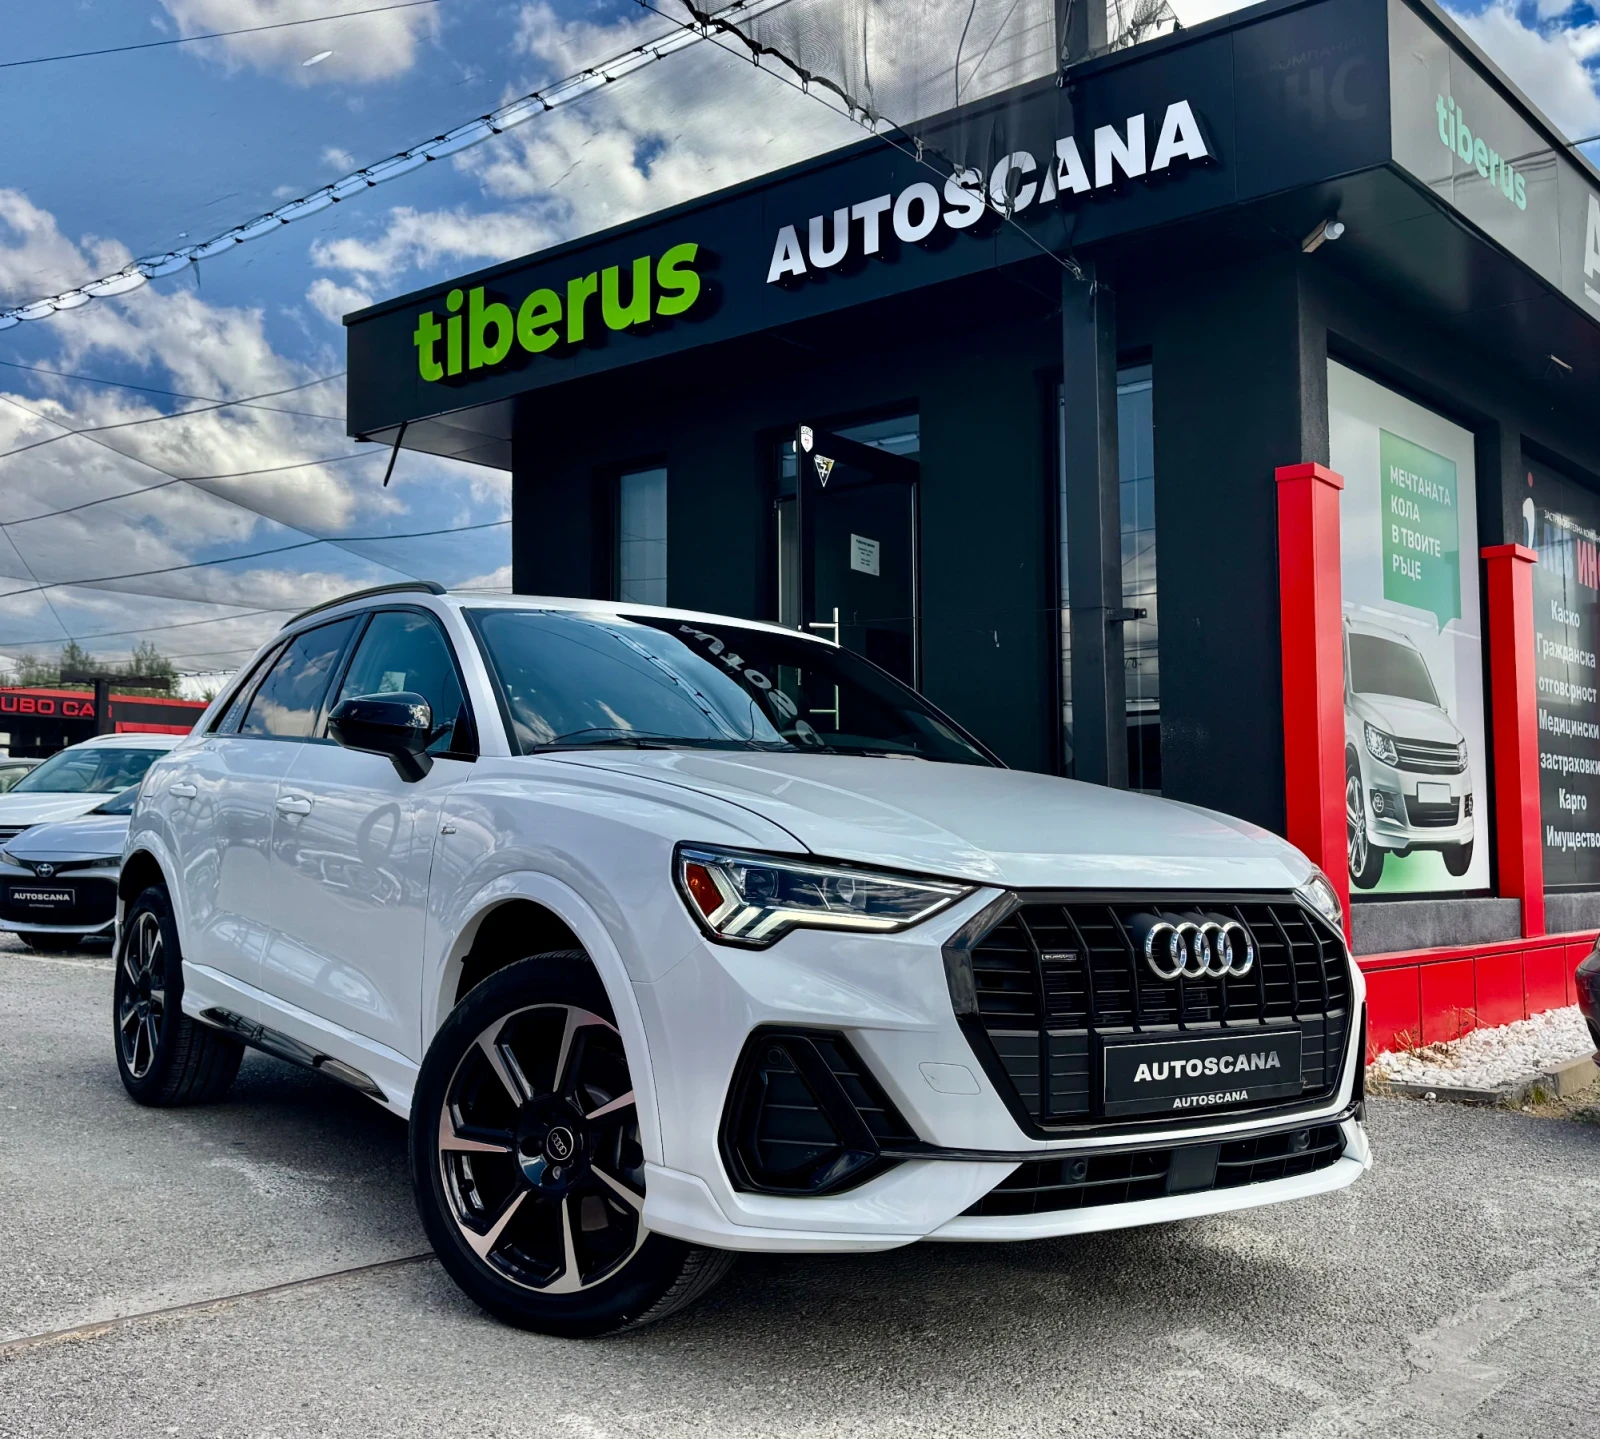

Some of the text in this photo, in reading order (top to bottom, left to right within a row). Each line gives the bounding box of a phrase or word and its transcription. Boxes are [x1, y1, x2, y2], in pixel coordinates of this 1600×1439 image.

[1435, 94, 1527, 211] tiberus
[767, 100, 1209, 284] AUTOSCANA
[413, 242, 701, 382] tiberus
[1391, 465, 1451, 506] МЕЧТАНАТА
[1391, 494, 1420, 523] КОЛА
[1391, 524, 1441, 558] В ТВОИТЕ
[1392, 553, 1422, 581] РЪЦЕ
[1551, 599, 1580, 628] Каско
[1536, 631, 1596, 669] Гражданска
[1538, 676, 1597, 704] отговорност
[1538, 708, 1600, 740] Медицински
[1540, 752, 1600, 777] застраховки
[1558, 787, 1588, 815] Карго
[14, 892, 70, 901] AUTOSCANA
[1134, 1051, 1281, 1082] AUTOSCANA
[1173, 1090, 1249, 1108] AUTOSCANA
